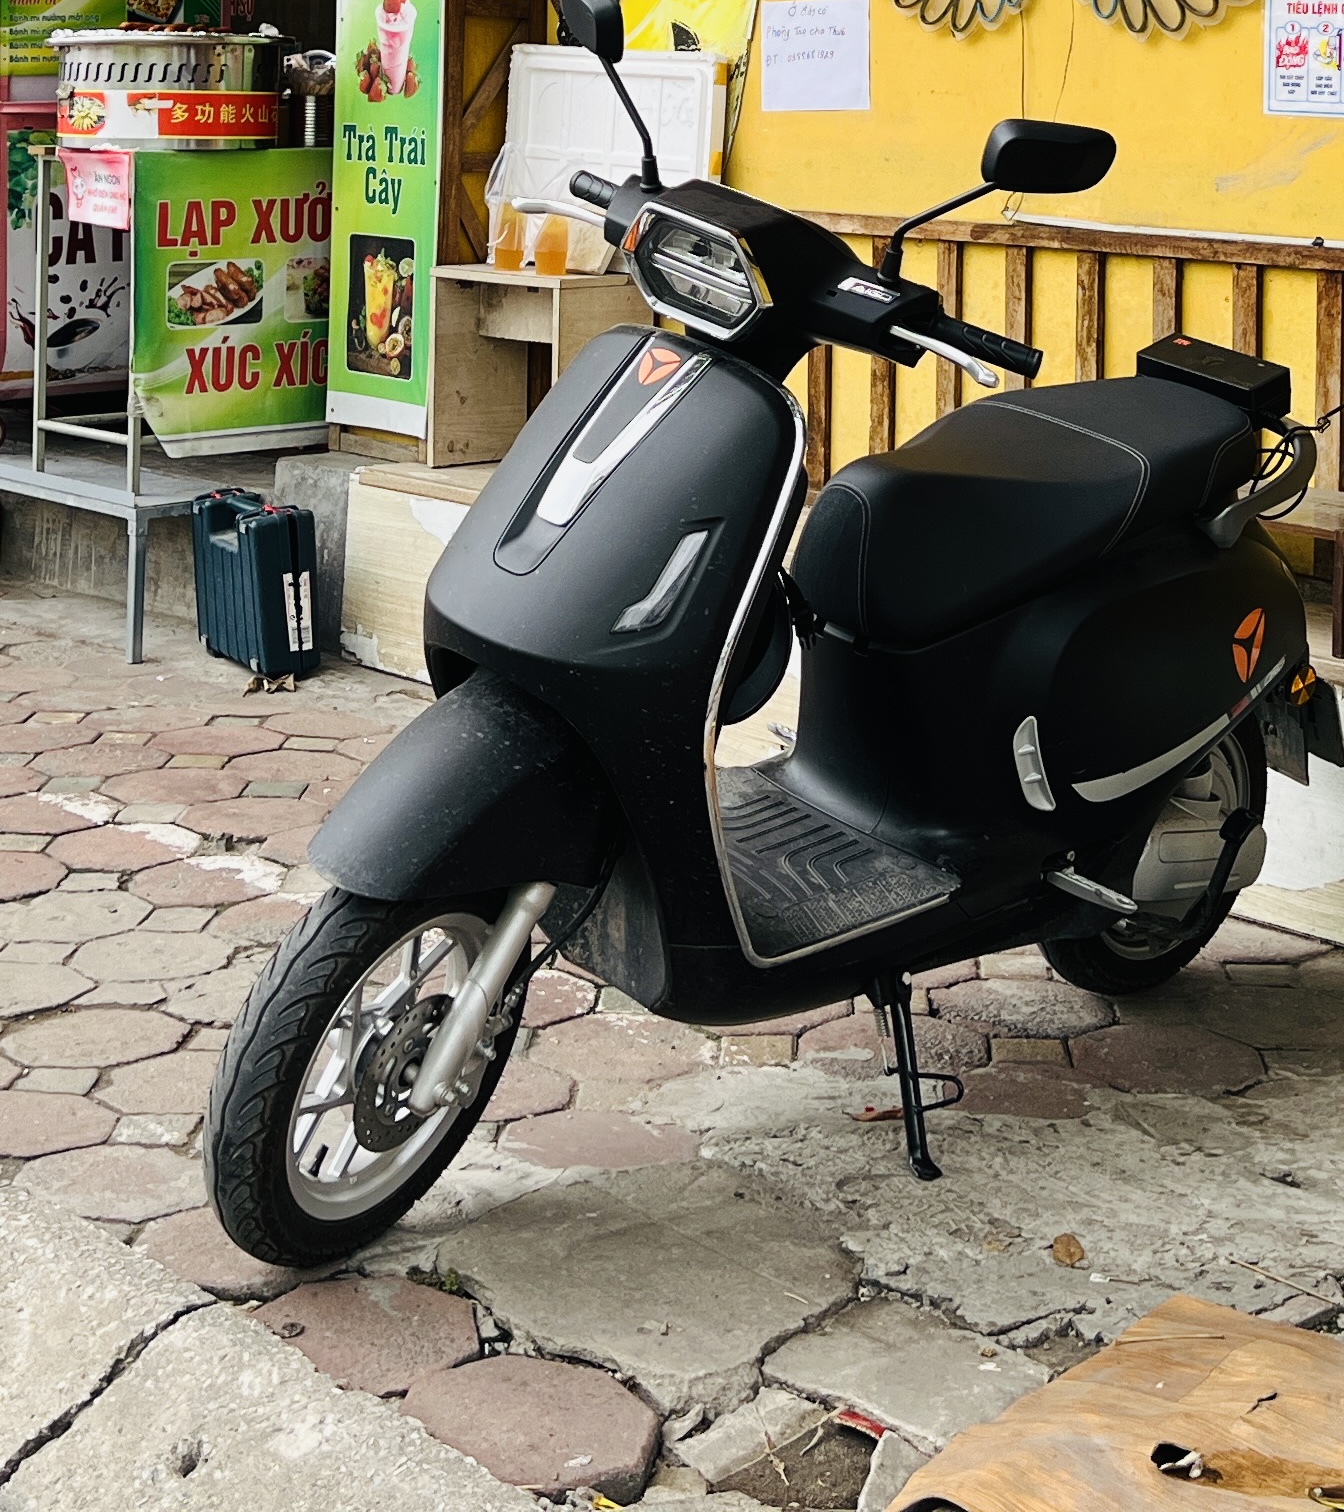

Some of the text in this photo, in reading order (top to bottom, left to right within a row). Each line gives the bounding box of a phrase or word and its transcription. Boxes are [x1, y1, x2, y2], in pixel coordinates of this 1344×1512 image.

[1290, 23, 1295, 32] 1
[1322, 23, 1330, 33] 2
[1311, 1, 1338, 18] LỆNH
[343, 124, 426, 165] Trà Trái
[365, 166, 402, 215] Cây
[157, 199, 237, 258] LẠP
[250, 181, 332, 245] XƯỞ
[185, 329, 329, 395] XÚC XÍC
